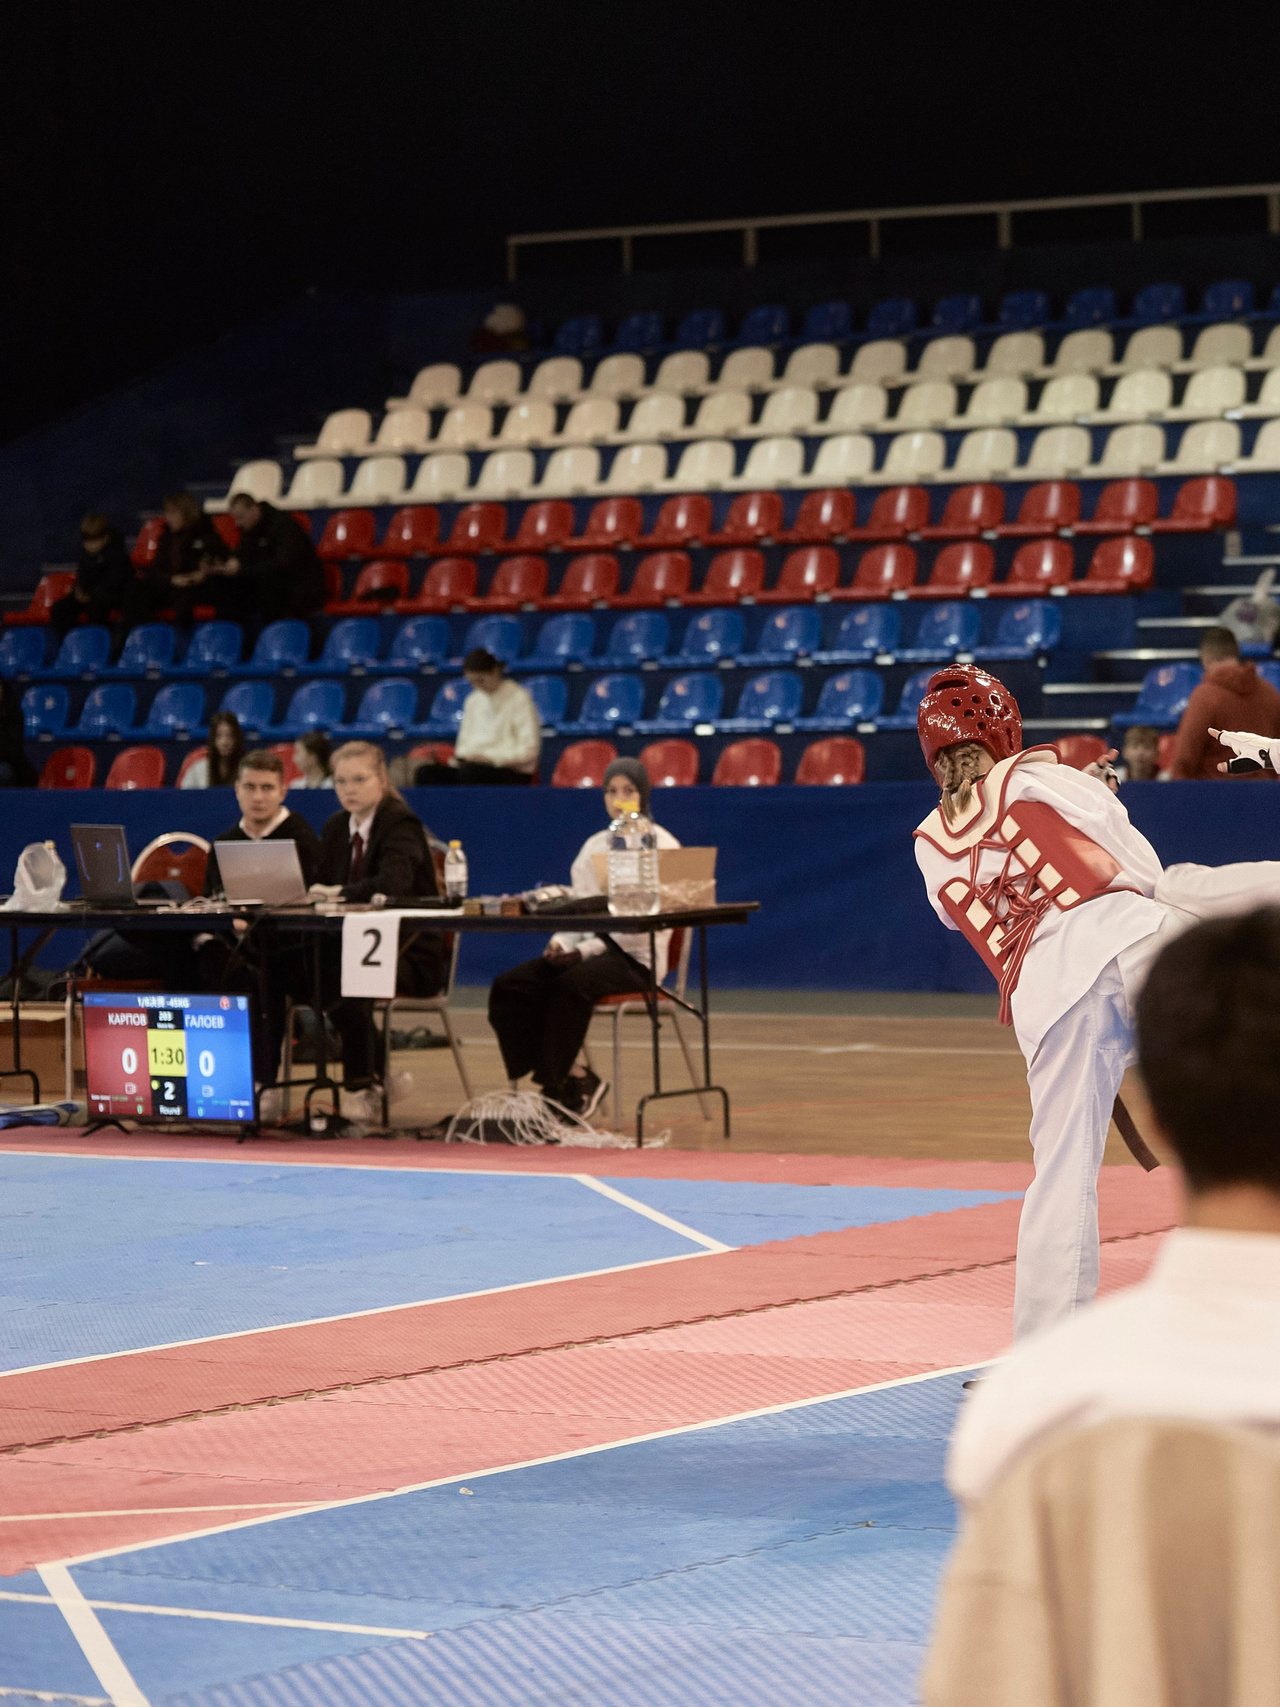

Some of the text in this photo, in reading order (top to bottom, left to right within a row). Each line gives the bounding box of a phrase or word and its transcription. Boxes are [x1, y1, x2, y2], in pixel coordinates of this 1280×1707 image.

[361, 928, 382, 967] 2
[108, 1012, 147, 1027] КАРПОВ
[184, 1015, 224, 1028] ГАЛОЕВ
[122, 1048, 137, 1074] 0
[152, 1048, 184, 1065] 1:30
[199, 1050, 214, 1077] 0
[163, 1081, 175, 1100] 2
[159, 1105, 181, 1116] Round
